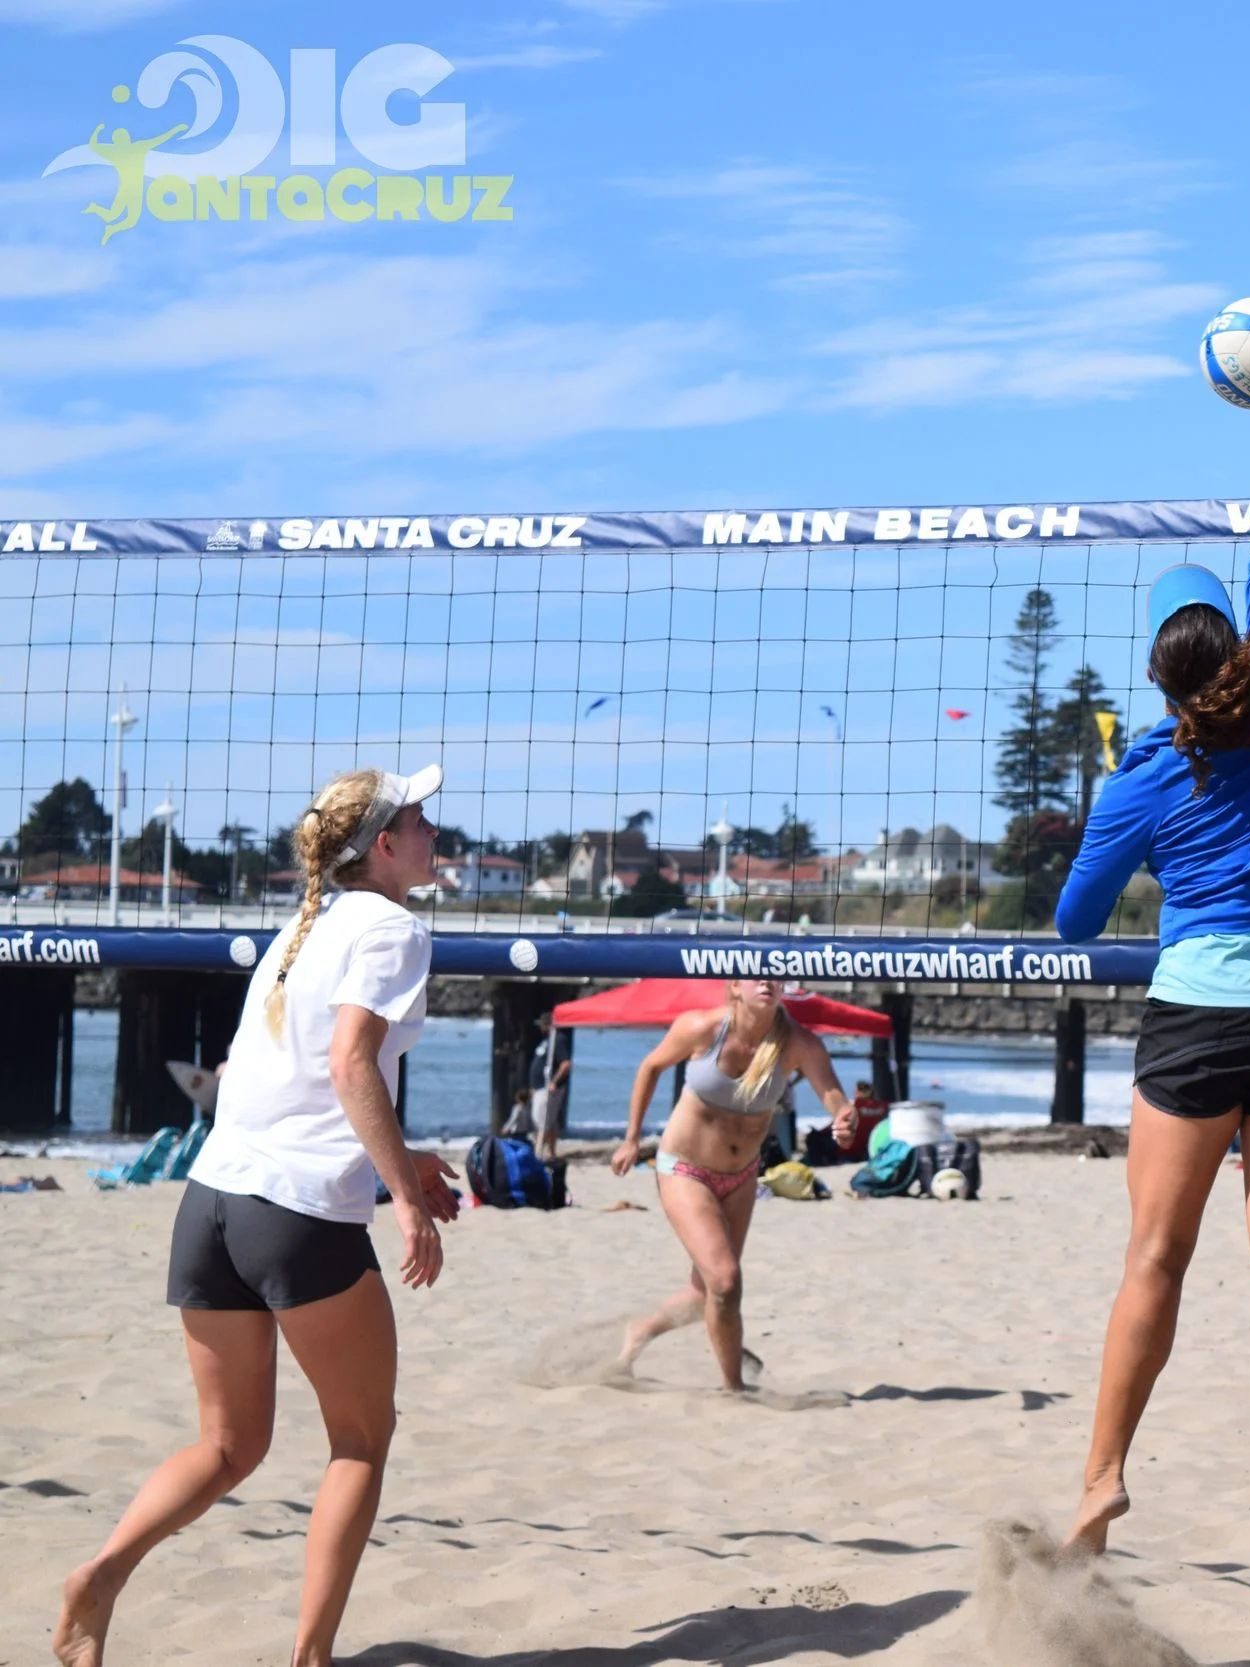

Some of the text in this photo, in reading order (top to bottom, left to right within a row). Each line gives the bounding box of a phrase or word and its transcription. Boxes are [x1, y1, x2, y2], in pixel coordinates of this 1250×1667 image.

[3, 522, 97, 551] ALL
[278, 519, 434, 549] SANTA
[447, 517, 587, 547] CRUZ
[702, 511, 849, 544] MAIN
[874, 506, 1081, 540] BEACH
[680, 943, 1092, 980] www.santacruzwharf.com
